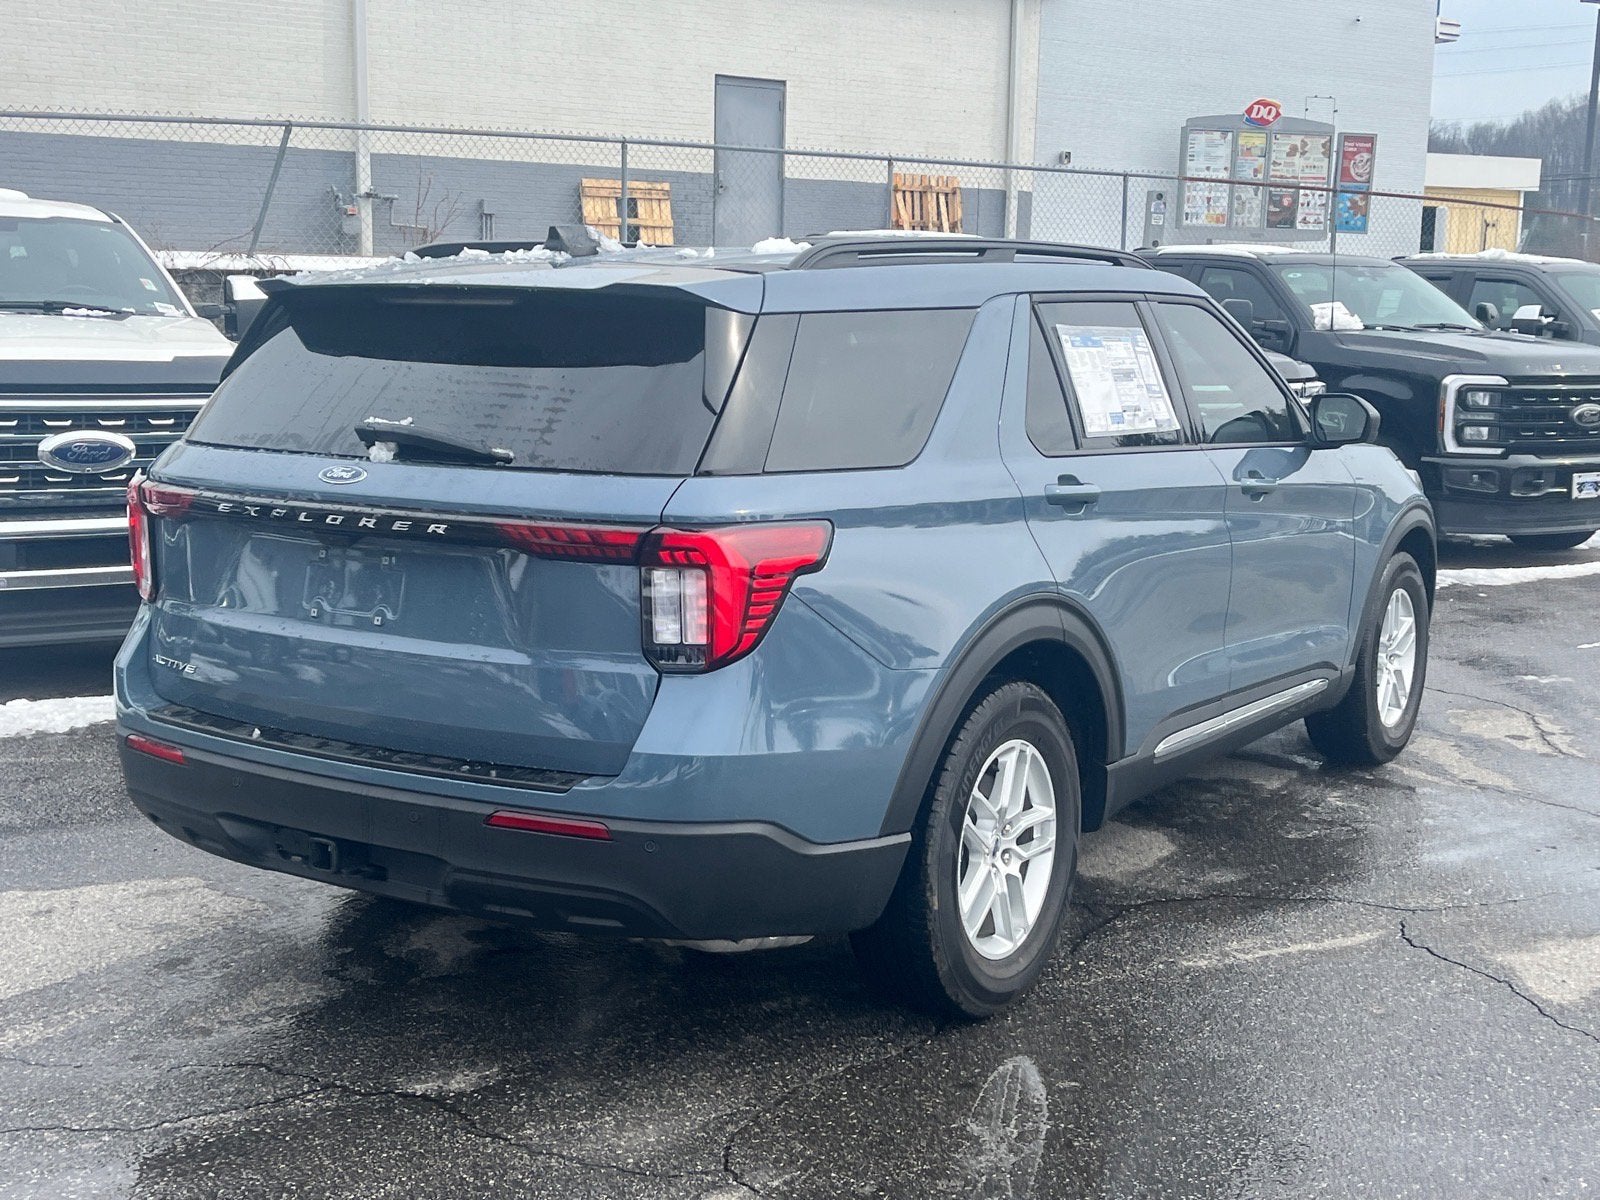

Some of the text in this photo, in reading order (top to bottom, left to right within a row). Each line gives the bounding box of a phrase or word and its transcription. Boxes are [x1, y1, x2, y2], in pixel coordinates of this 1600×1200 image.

[1250, 104, 1277, 121] DQ
[67, 442, 111, 459] Ford
[326, 466, 356, 479] Ford
[217, 502, 448, 535] EXPLORER
